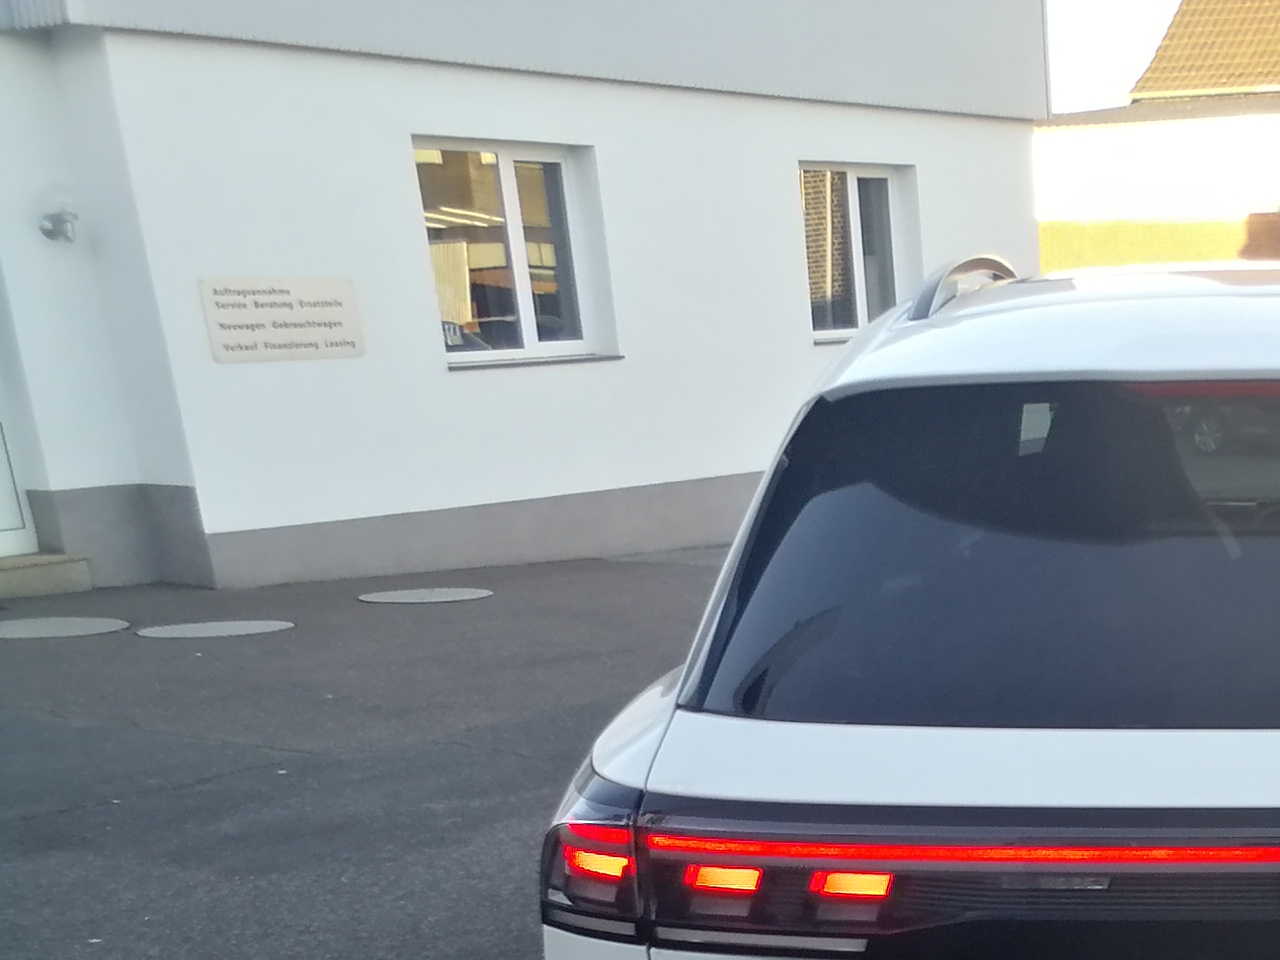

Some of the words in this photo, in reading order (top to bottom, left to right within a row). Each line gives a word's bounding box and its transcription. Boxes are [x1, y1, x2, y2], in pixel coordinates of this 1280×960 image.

[213, 288, 291, 298] Auftragsannahme
[215, 301, 248, 310] Service
[254, 301, 294, 311] Beratung
[299, 299, 343, 309] Ersatzteile
[219, 322, 267, 332] Neuwagen
[272, 320, 343, 330] Gebrauchtwagen
[223, 343, 259, 352] Verkauf
[264, 341, 320, 351] Finanzierung
[324, 339, 356, 349] Leasing
